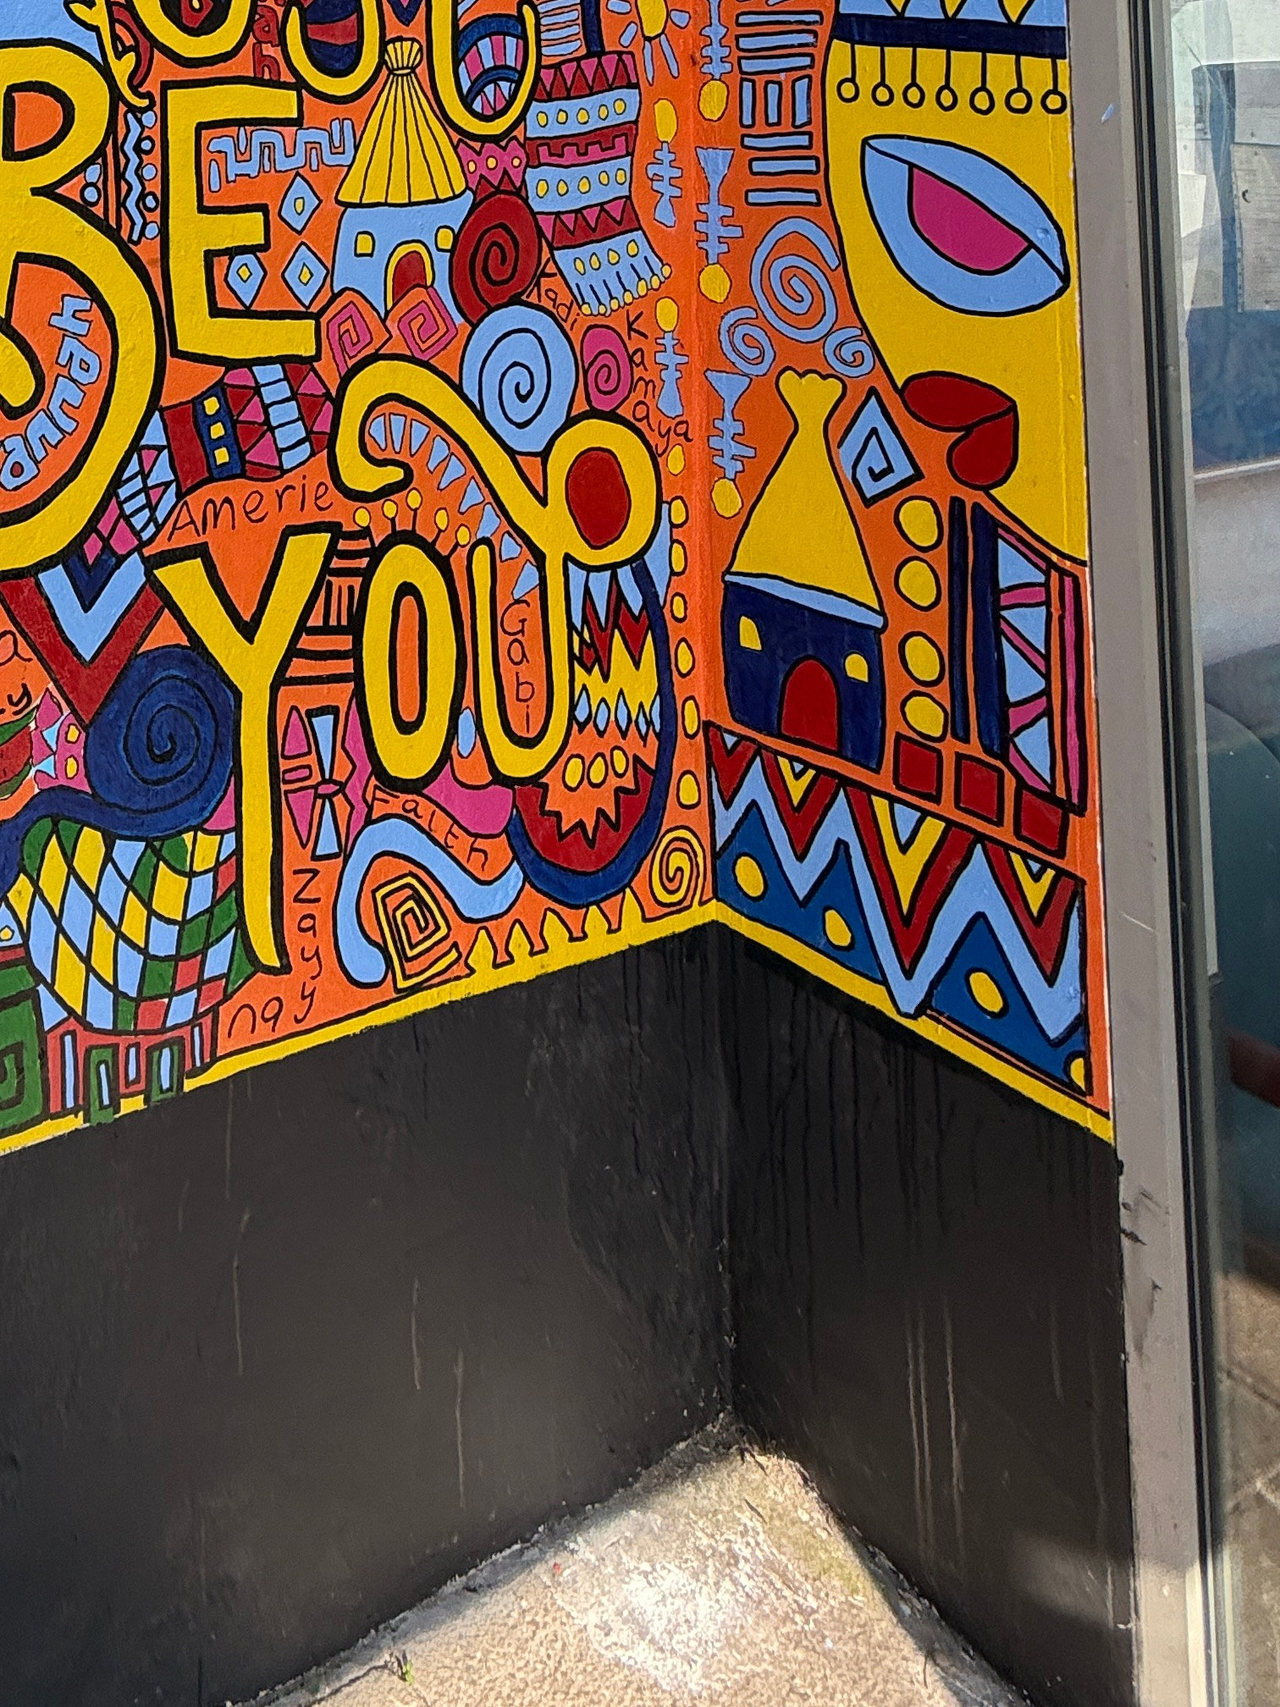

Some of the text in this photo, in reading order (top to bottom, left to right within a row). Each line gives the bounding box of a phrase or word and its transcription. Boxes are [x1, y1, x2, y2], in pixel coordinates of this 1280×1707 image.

[626, 309, 693, 457] Kamaya
[167, 474, 333, 542] Amerie
[500, 599, 535, 734] Gabi
